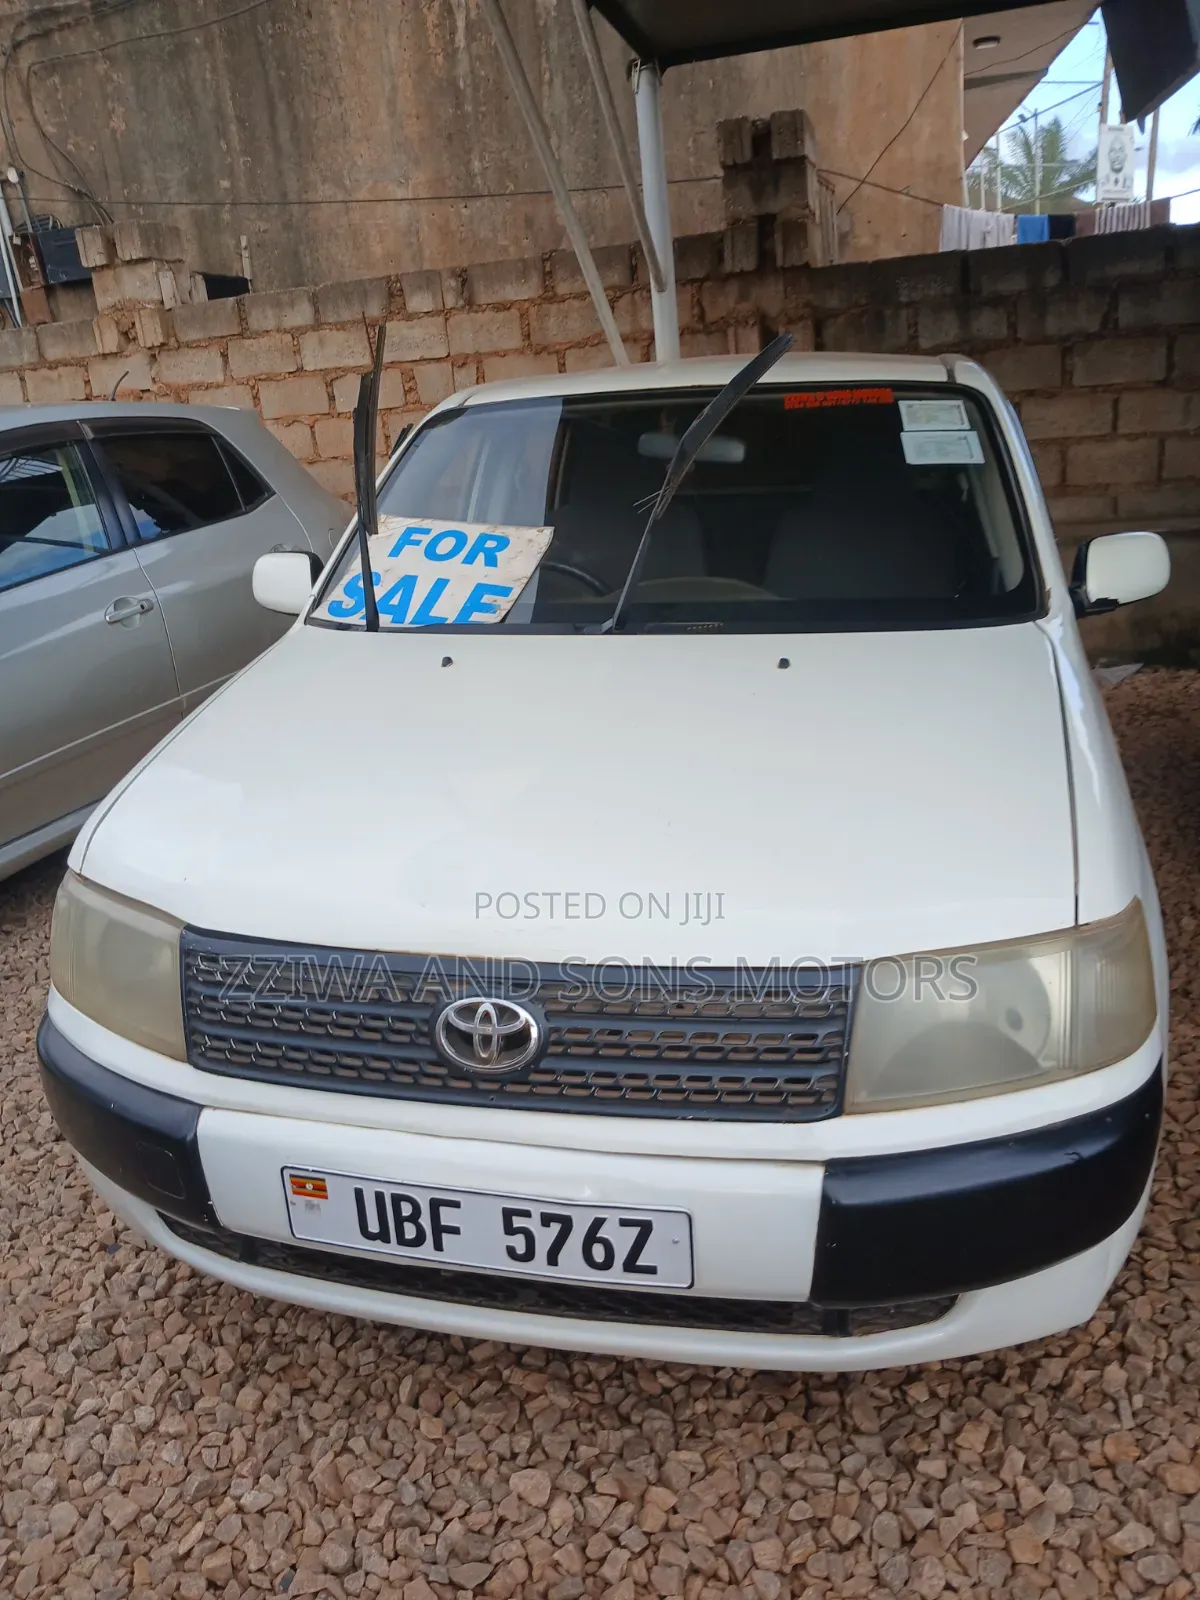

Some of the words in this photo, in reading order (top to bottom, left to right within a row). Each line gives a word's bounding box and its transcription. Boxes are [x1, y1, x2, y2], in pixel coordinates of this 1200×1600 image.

[387, 527, 511, 568] FOR
[327, 571, 514, 625] SALE
[354, 1187, 462, 1252] UBF
[501, 1206, 658, 1275] 576Z
